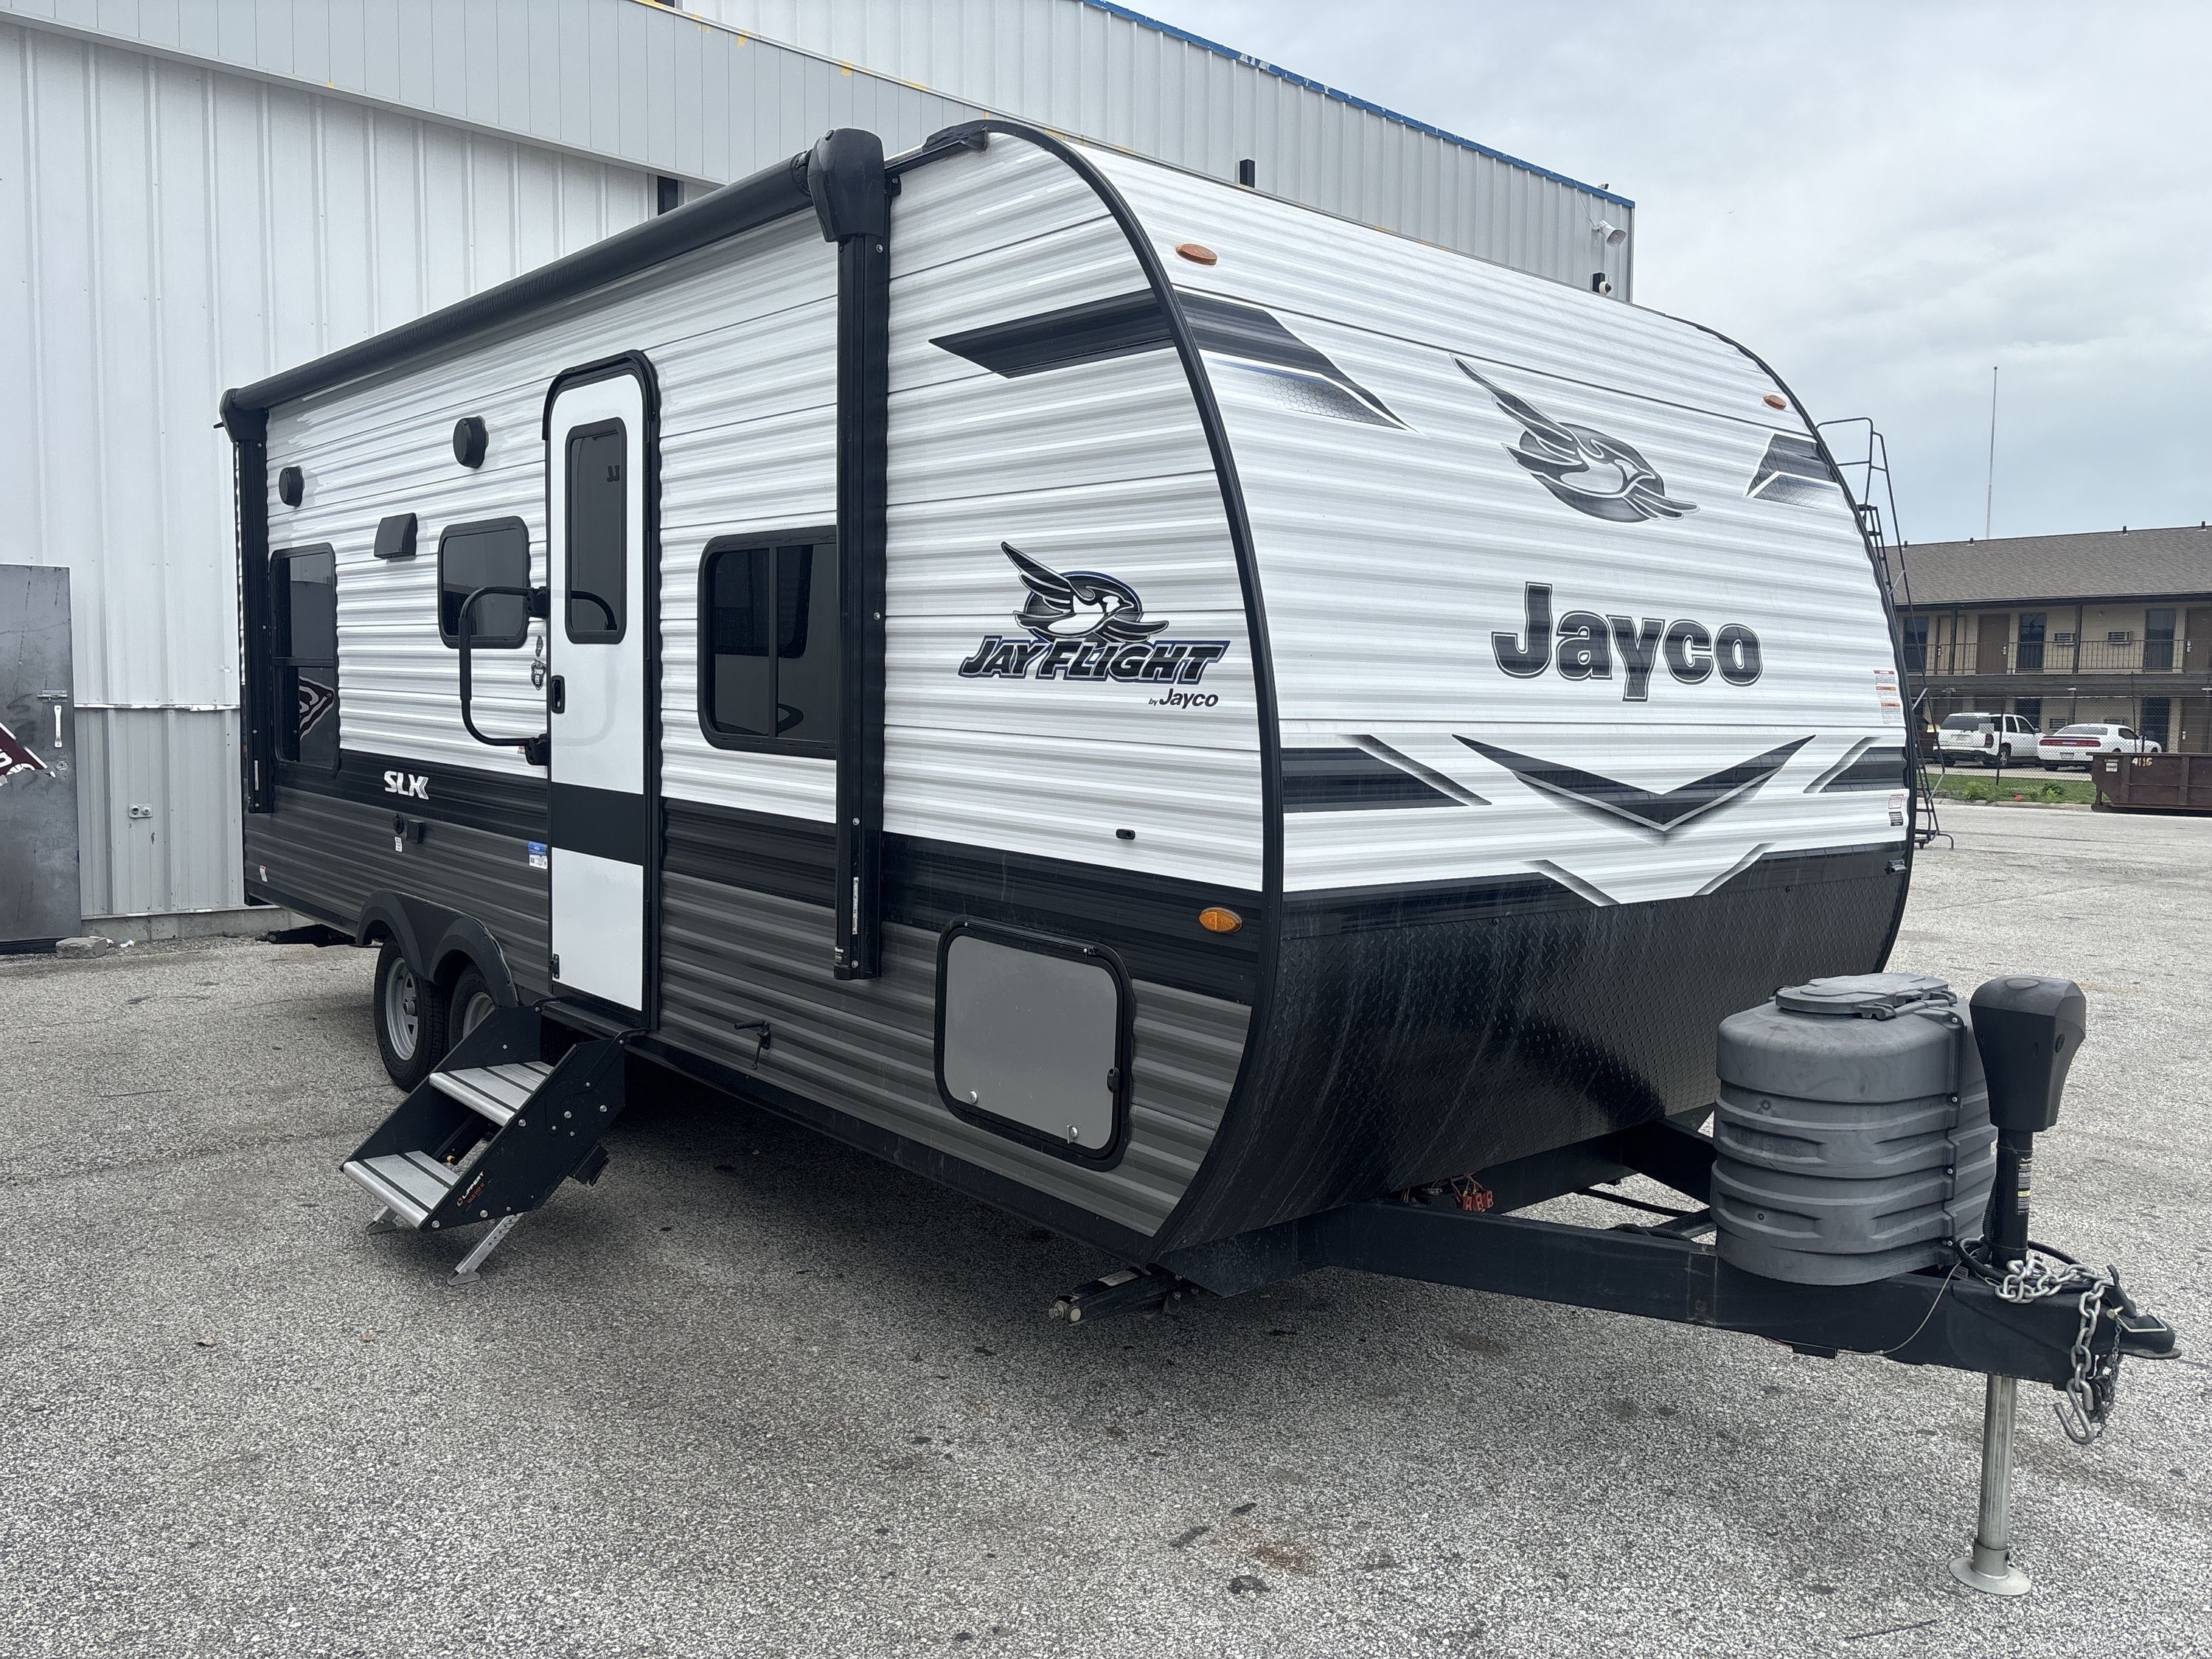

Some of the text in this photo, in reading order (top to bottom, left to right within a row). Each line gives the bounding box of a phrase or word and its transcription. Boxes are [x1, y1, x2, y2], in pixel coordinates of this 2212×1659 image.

[959, 636, 1231, 685] JAY FLIGHT
[1491, 581, 1763, 702] Jayco
[1148, 689, 1219, 709] by Jayco
